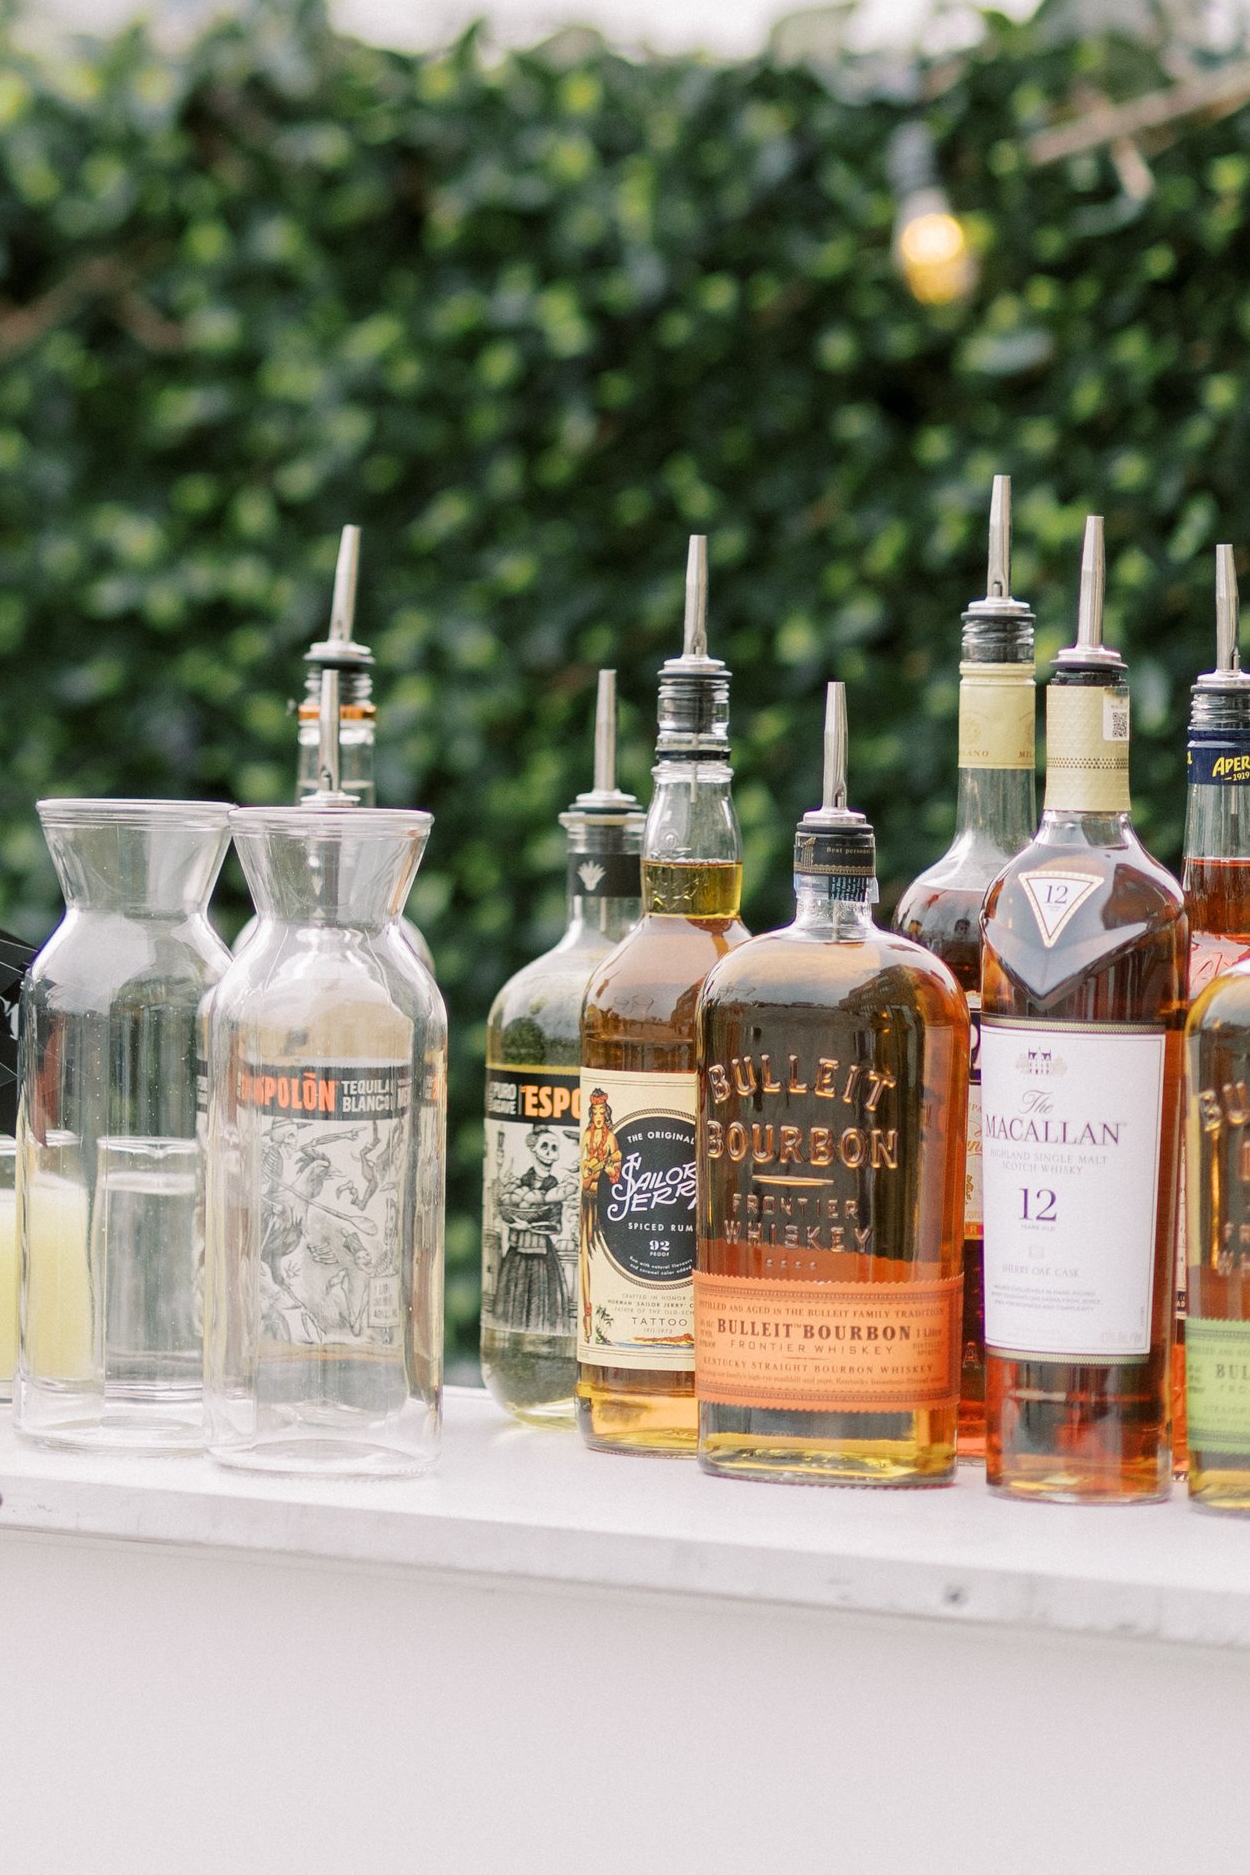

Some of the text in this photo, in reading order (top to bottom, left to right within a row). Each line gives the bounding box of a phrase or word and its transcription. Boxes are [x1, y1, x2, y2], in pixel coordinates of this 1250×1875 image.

[1043, 885, 1068, 904] 12
[709, 1054, 896, 1111] BULLEIT
[1018, 1089, 1055, 1115] The
[627, 1131, 695, 1145] THE ORIGINAL
[985, 1113, 1121, 1146] MACALLAN
[707, 1120, 898, 1169] BOURBON
[990, 1148, 1108, 1166] HIGHLAND SINGLE MALT
[1041, 1165, 1084, 1175] WHISKY
[607, 1152, 697, 1222] JERR
[611, 1159, 696, 1201] SAILOR
[732, 1193, 860, 1221] FRONTIER
[1019, 1188, 1057, 1222] 12
[628, 1222, 694, 1233] SPICED RUM
[724, 1219, 872, 1254] WHISKEY
[649, 1239, 671, 1252] 92
[729, 1304, 743, 1312] AND
[747, 1305, 770, 1315] AGED
[785, 1308, 803, 1317] THE
[808, 1309, 849, 1318] BULLEIT
[853, 1309, 890, 1318] FAMILY
[631, 1316, 688, 1327] TATTOO
[803, 1324, 911, 1341] BOURBON
[730, 1339, 893, 1356] FRONTIER WHISKEY
[751, 1361, 808, 1373] STRAIGHT
[814, 1364, 873, 1374] BOURBON
[880, 1364, 933, 1374] WHISKEY
